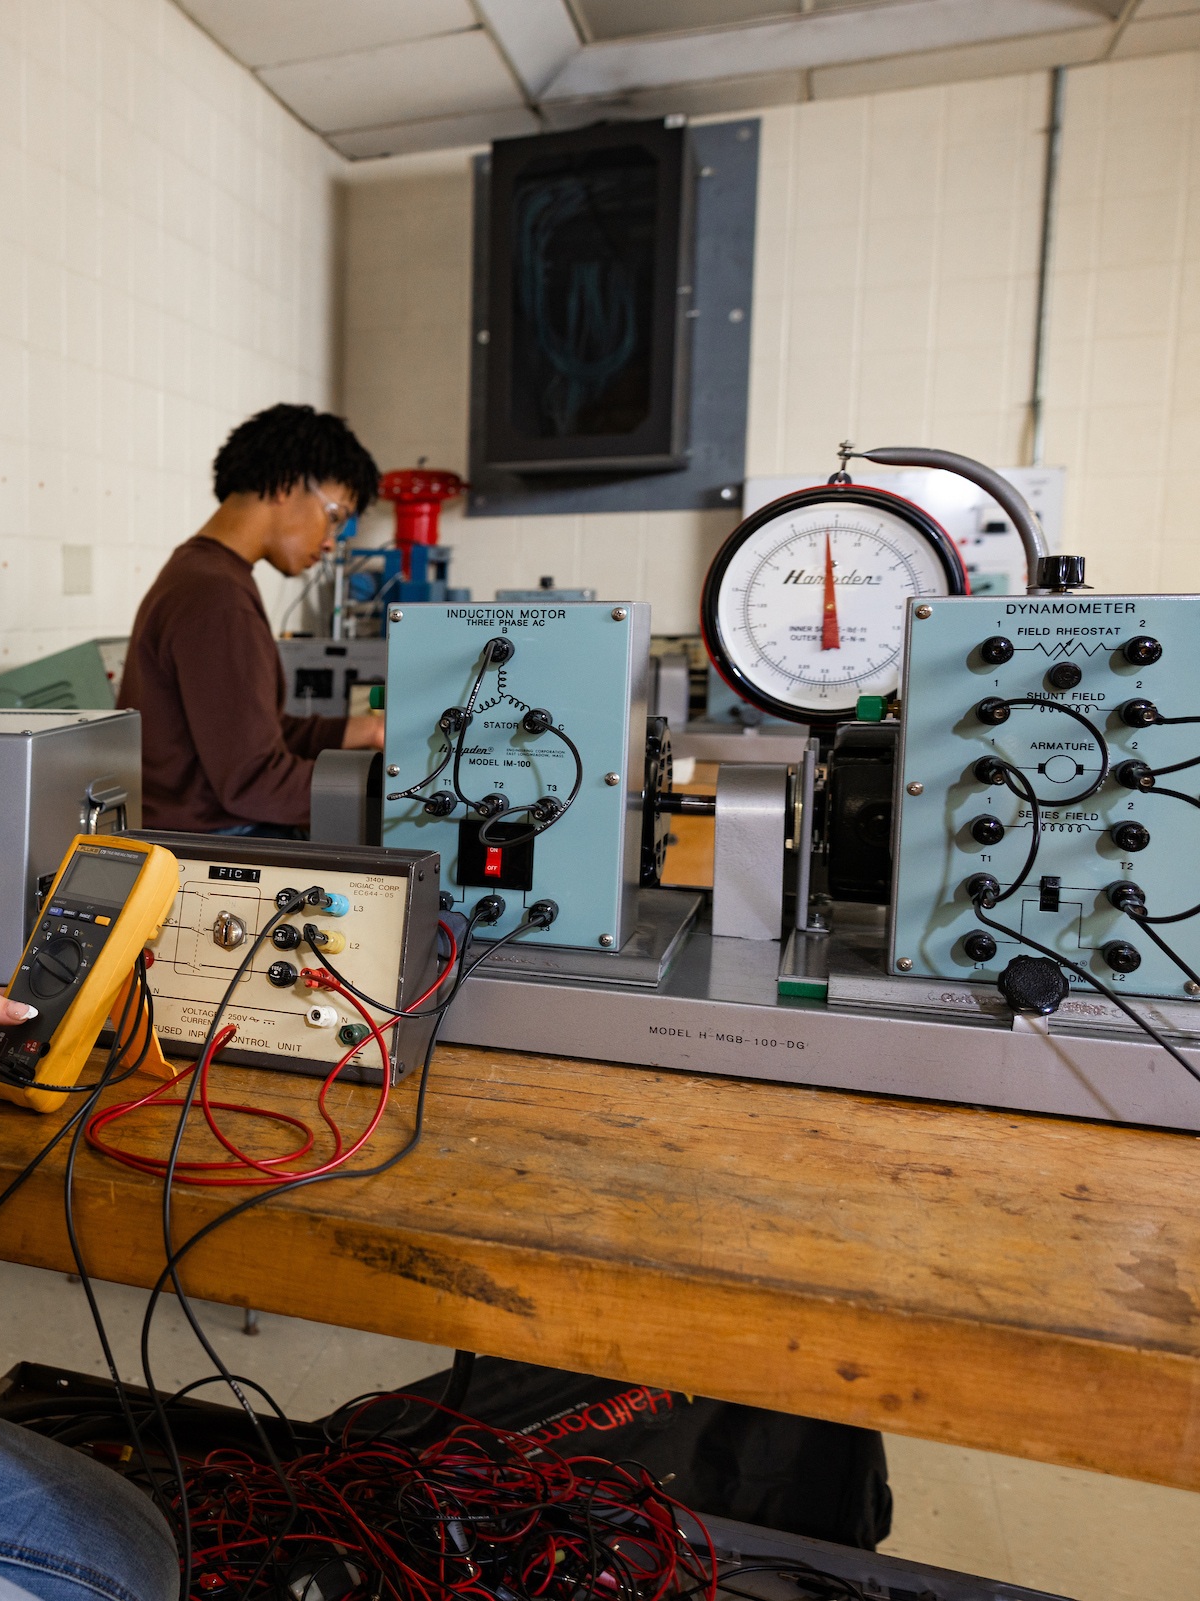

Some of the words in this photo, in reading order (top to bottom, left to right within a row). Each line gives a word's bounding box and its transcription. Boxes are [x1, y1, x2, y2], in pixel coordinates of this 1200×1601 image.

[1006, 602, 1136, 615] DYNAMOMETER
[447, 609, 514, 619] INDUCTION
[520, 609, 566, 619] MOTOR
[499, 619, 529, 627] PHASE
[532, 619, 545, 627] AC
[996, 620, 1001, 628] 1
[1139, 619, 1146, 628] 2
[1017, 627, 1051, 636] FIELD
[1056, 627, 1121, 636] RHEOSTAT
[790, 634, 817, 642] OUTER
[994, 679, 999, 687] 1
[1136, 680, 1143, 689] 2
[1026, 691, 1066, 700] SHUNT
[1072, 692, 1106, 701] FIELD
[483, 721, 519, 730] STATOR
[991, 738, 995, 746] 1
[1030, 742, 1095, 751] ARMATURE
[1132, 742, 1138, 750] 2
[468, 758, 500, 766] MODEL
[503, 759, 531, 768] IM-100
[443, 778, 452, 786] T1
[493, 781, 504, 789] T2
[546, 784, 557, 792] T3
[1127, 802, 1134, 810] 2
[1018, 810, 1060, 819] SEIES
[1065, 811, 1099, 821] FIELD
[980, 854, 991, 862] T1
[1120, 861, 1134, 871] T2
[252, 871, 257, 880] 1
[378, 884, 400, 892] CORP.
[353, 905, 364, 913] L3
[349, 942, 360, 950] L2
[974, 962, 984, 970] L1
[1111, 973, 1126, 982] L2
[180, 1015, 213, 1026] CURREN
[227, 1013, 248, 1022] 250V
[649, 1026, 692, 1038] MODEL
[699, 1032, 804, 1050] H-MGB-100-DG
[277, 1042, 303, 1052] UNIT
